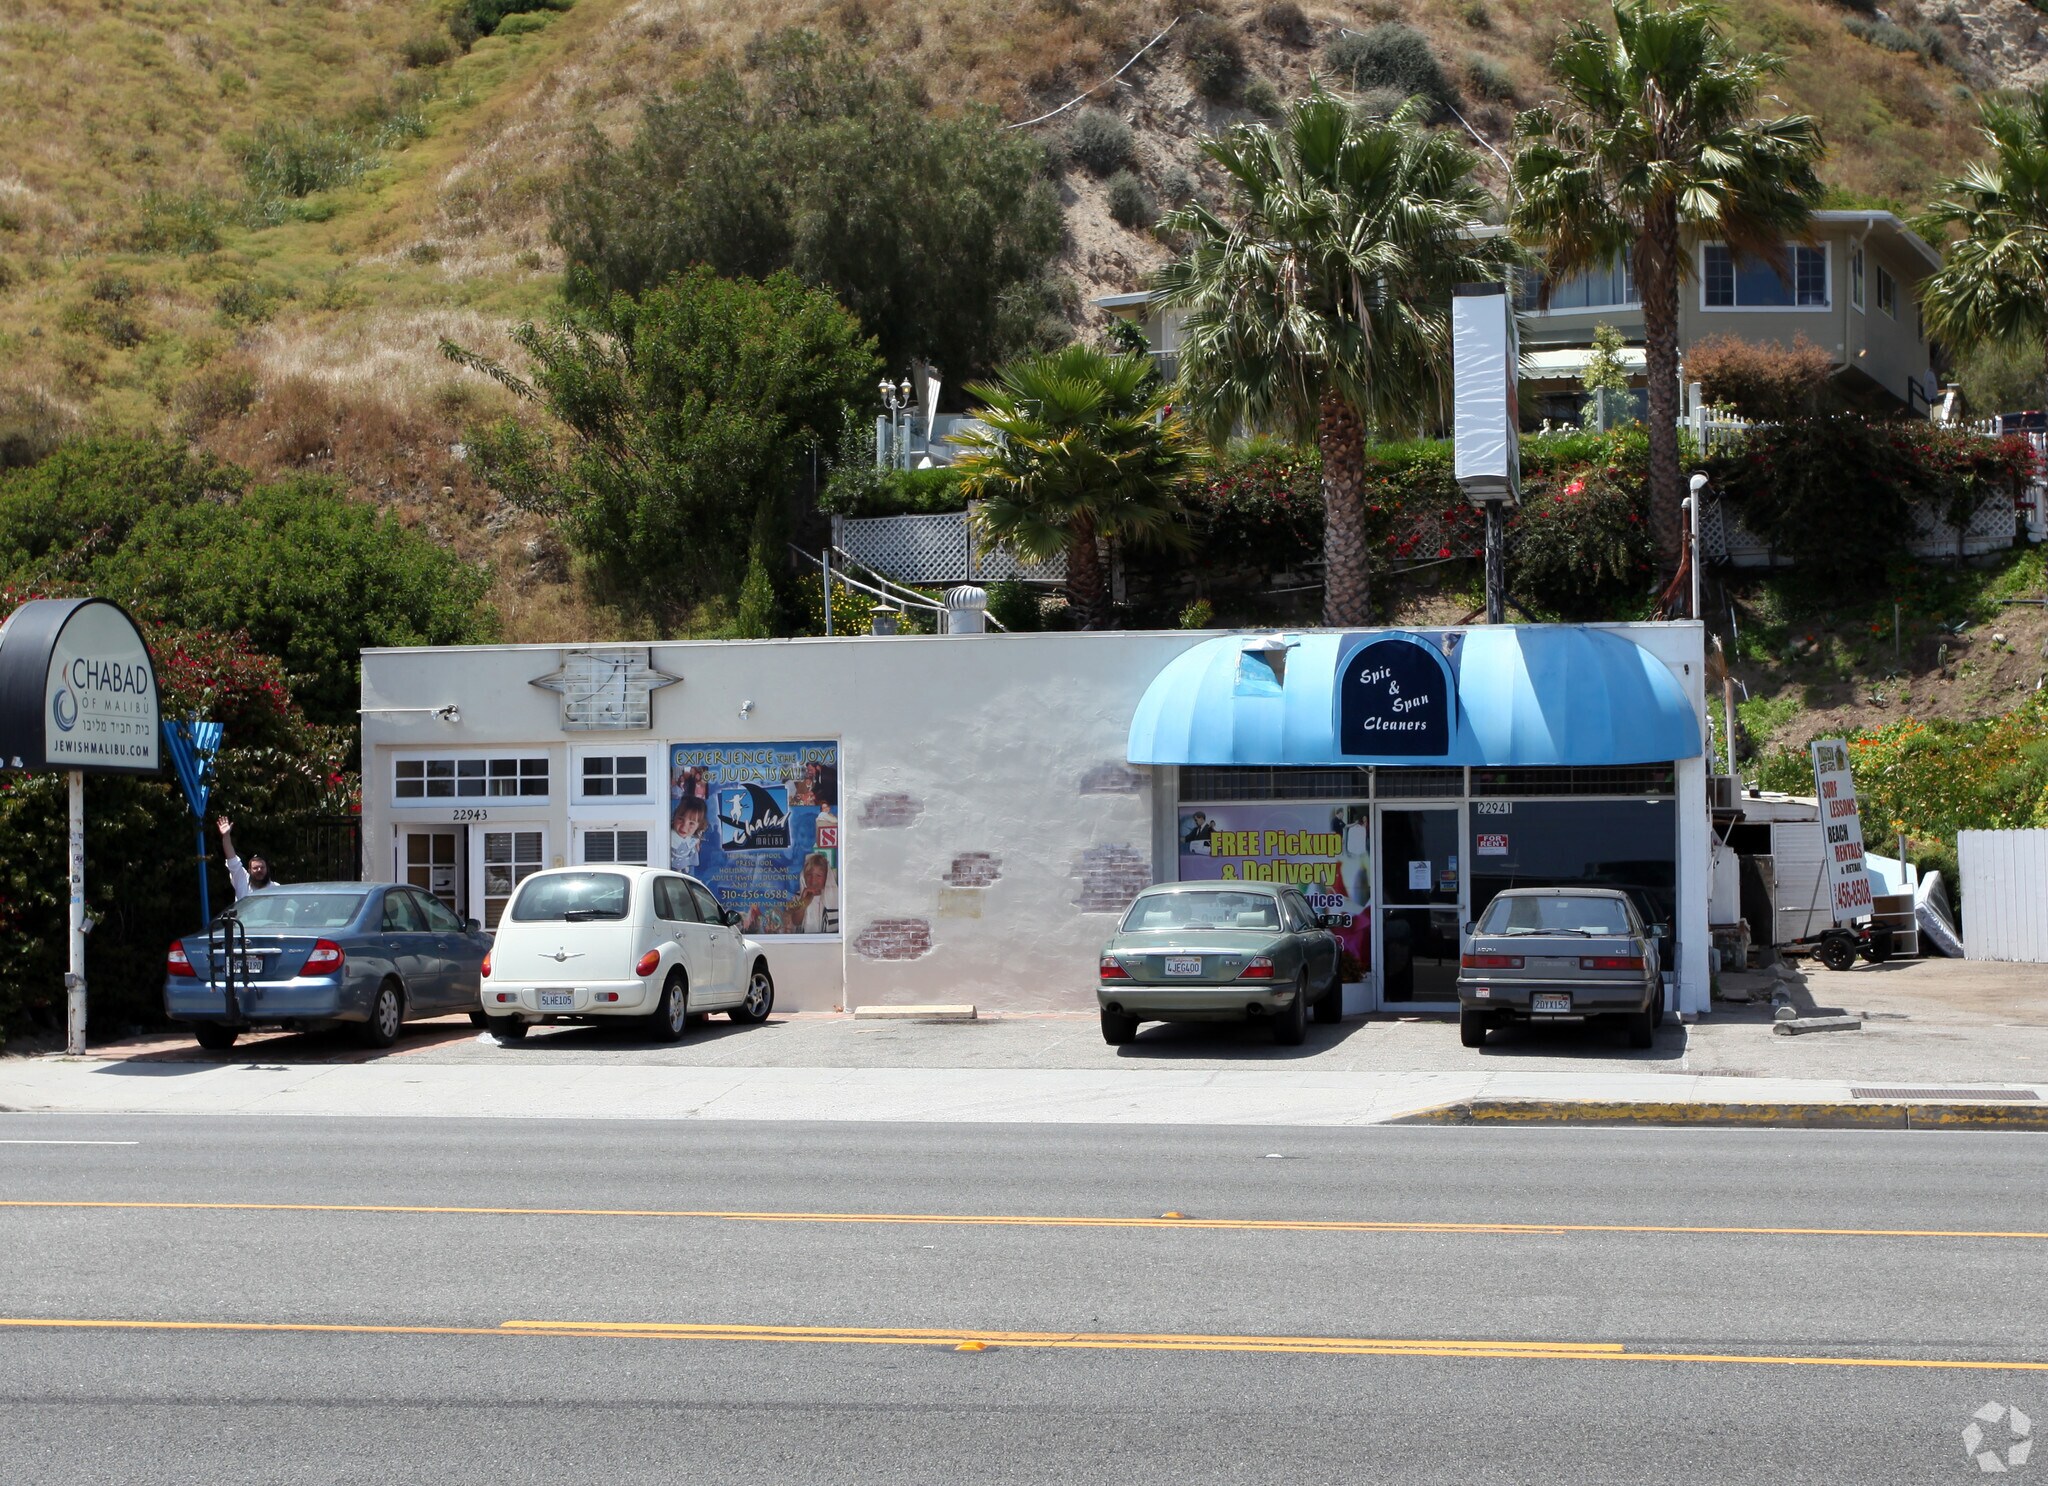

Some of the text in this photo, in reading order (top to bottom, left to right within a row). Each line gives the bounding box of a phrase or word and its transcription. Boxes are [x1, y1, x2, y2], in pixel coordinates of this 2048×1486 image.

[72, 658, 148, 695] CHABAD
[1360, 666, 1391, 685] Spic
[1388, 680, 1400, 695] &
[82, 697, 149, 714] OF MALIBU
[1392, 695, 1429, 713] Span
[1363, 716, 1427, 731] Cleaners
[54, 740, 149, 757] JEWISHMALIBU.COM
[675, 748, 836, 765] EXPERIENCE THE JOYS
[703, 772, 716, 782] OF
[1822, 781, 1838, 799] SURF
[453, 809, 488, 821] 22943
[1479, 803, 1511, 814] 22941
[1829, 798, 1857, 818] LESSONS
[755, 837, 784, 846] MALIBU
[1827, 823, 1849, 844] BEACH
[1211, 829, 1343, 857] FREE Pickup
[1835, 841, 1863, 862] RENTALS
[1221, 860, 1338, 886] & Delivery
[1304, 893, 1344, 908] vices
[1837, 878, 1872, 909] 456-8508
[1167, 963, 1200, 973] 4JEG400
[541, 996, 572, 1006] 5LHE105
